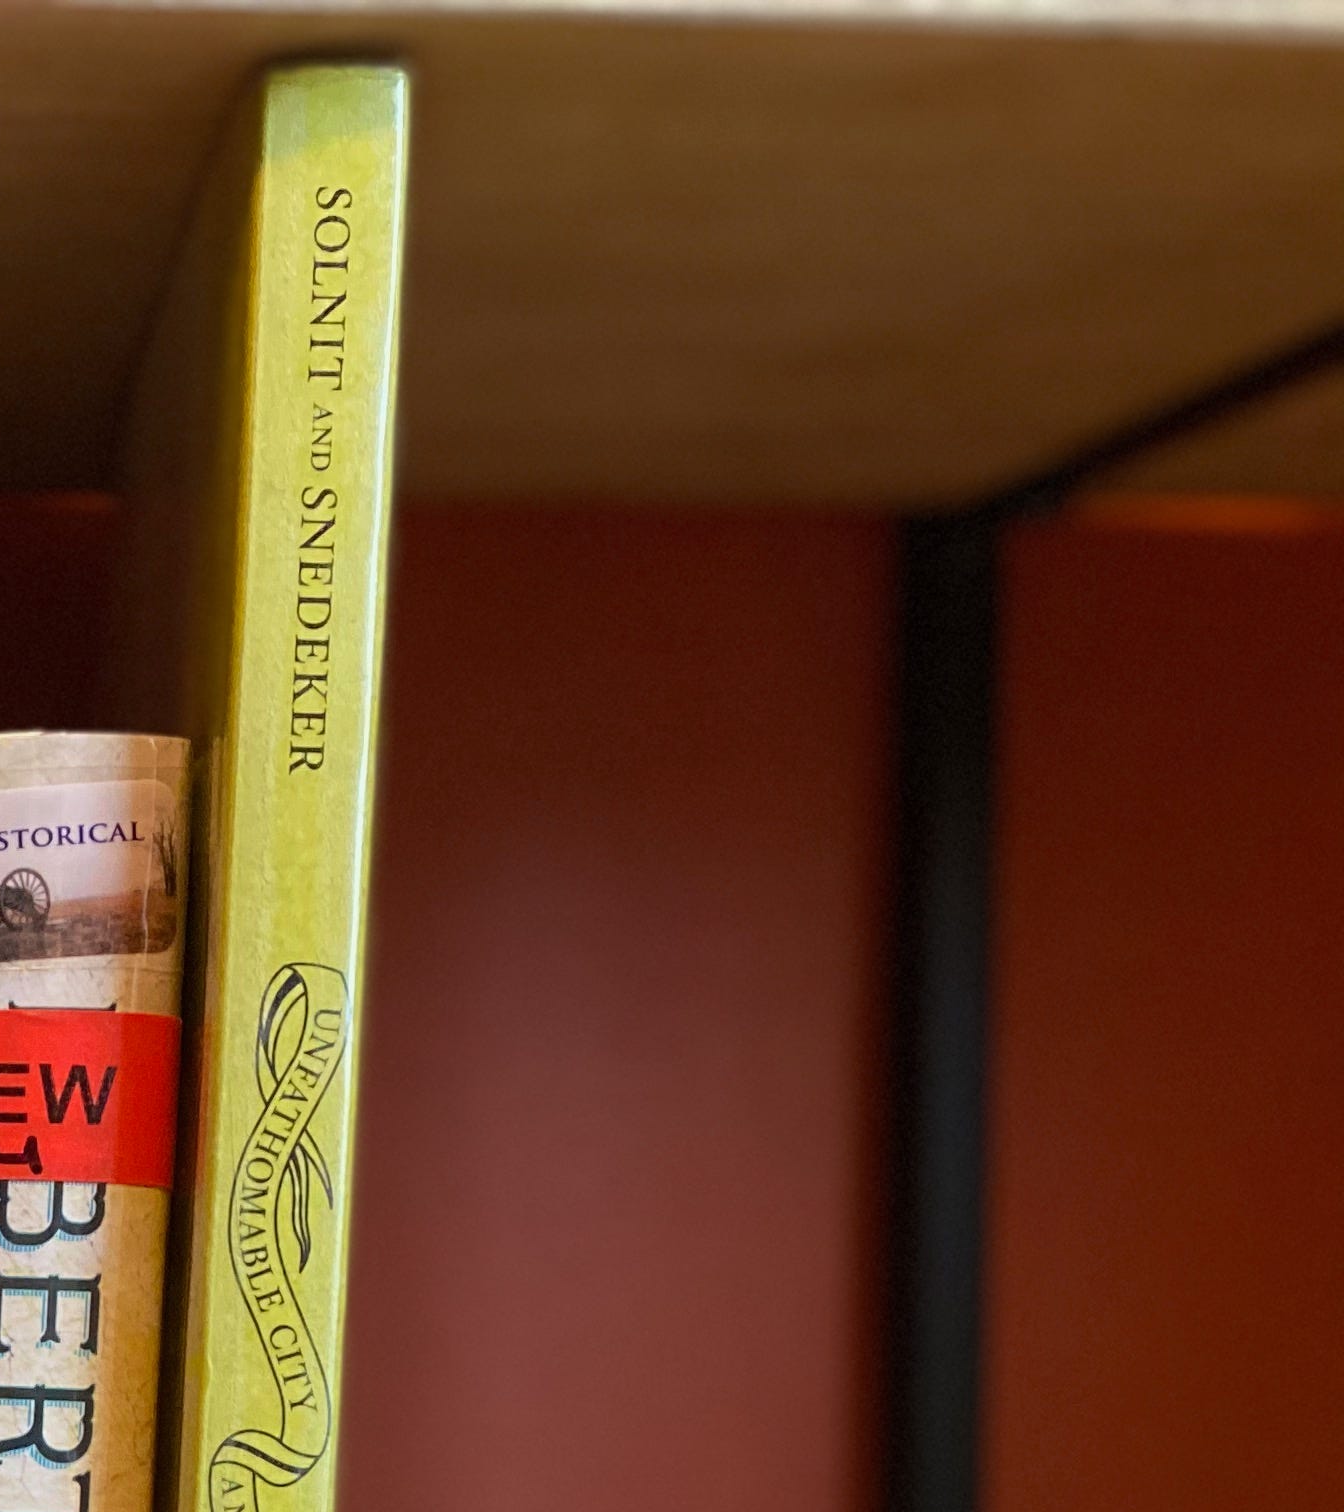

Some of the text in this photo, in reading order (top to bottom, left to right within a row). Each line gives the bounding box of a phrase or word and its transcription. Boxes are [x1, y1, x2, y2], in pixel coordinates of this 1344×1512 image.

[289, 186, 352, 775] SOLNIT AND SNEDEKER
[238, 1007, 342, 1411] UNFATHOMABLE CITY
[221, 1477, 245, 1496] A
